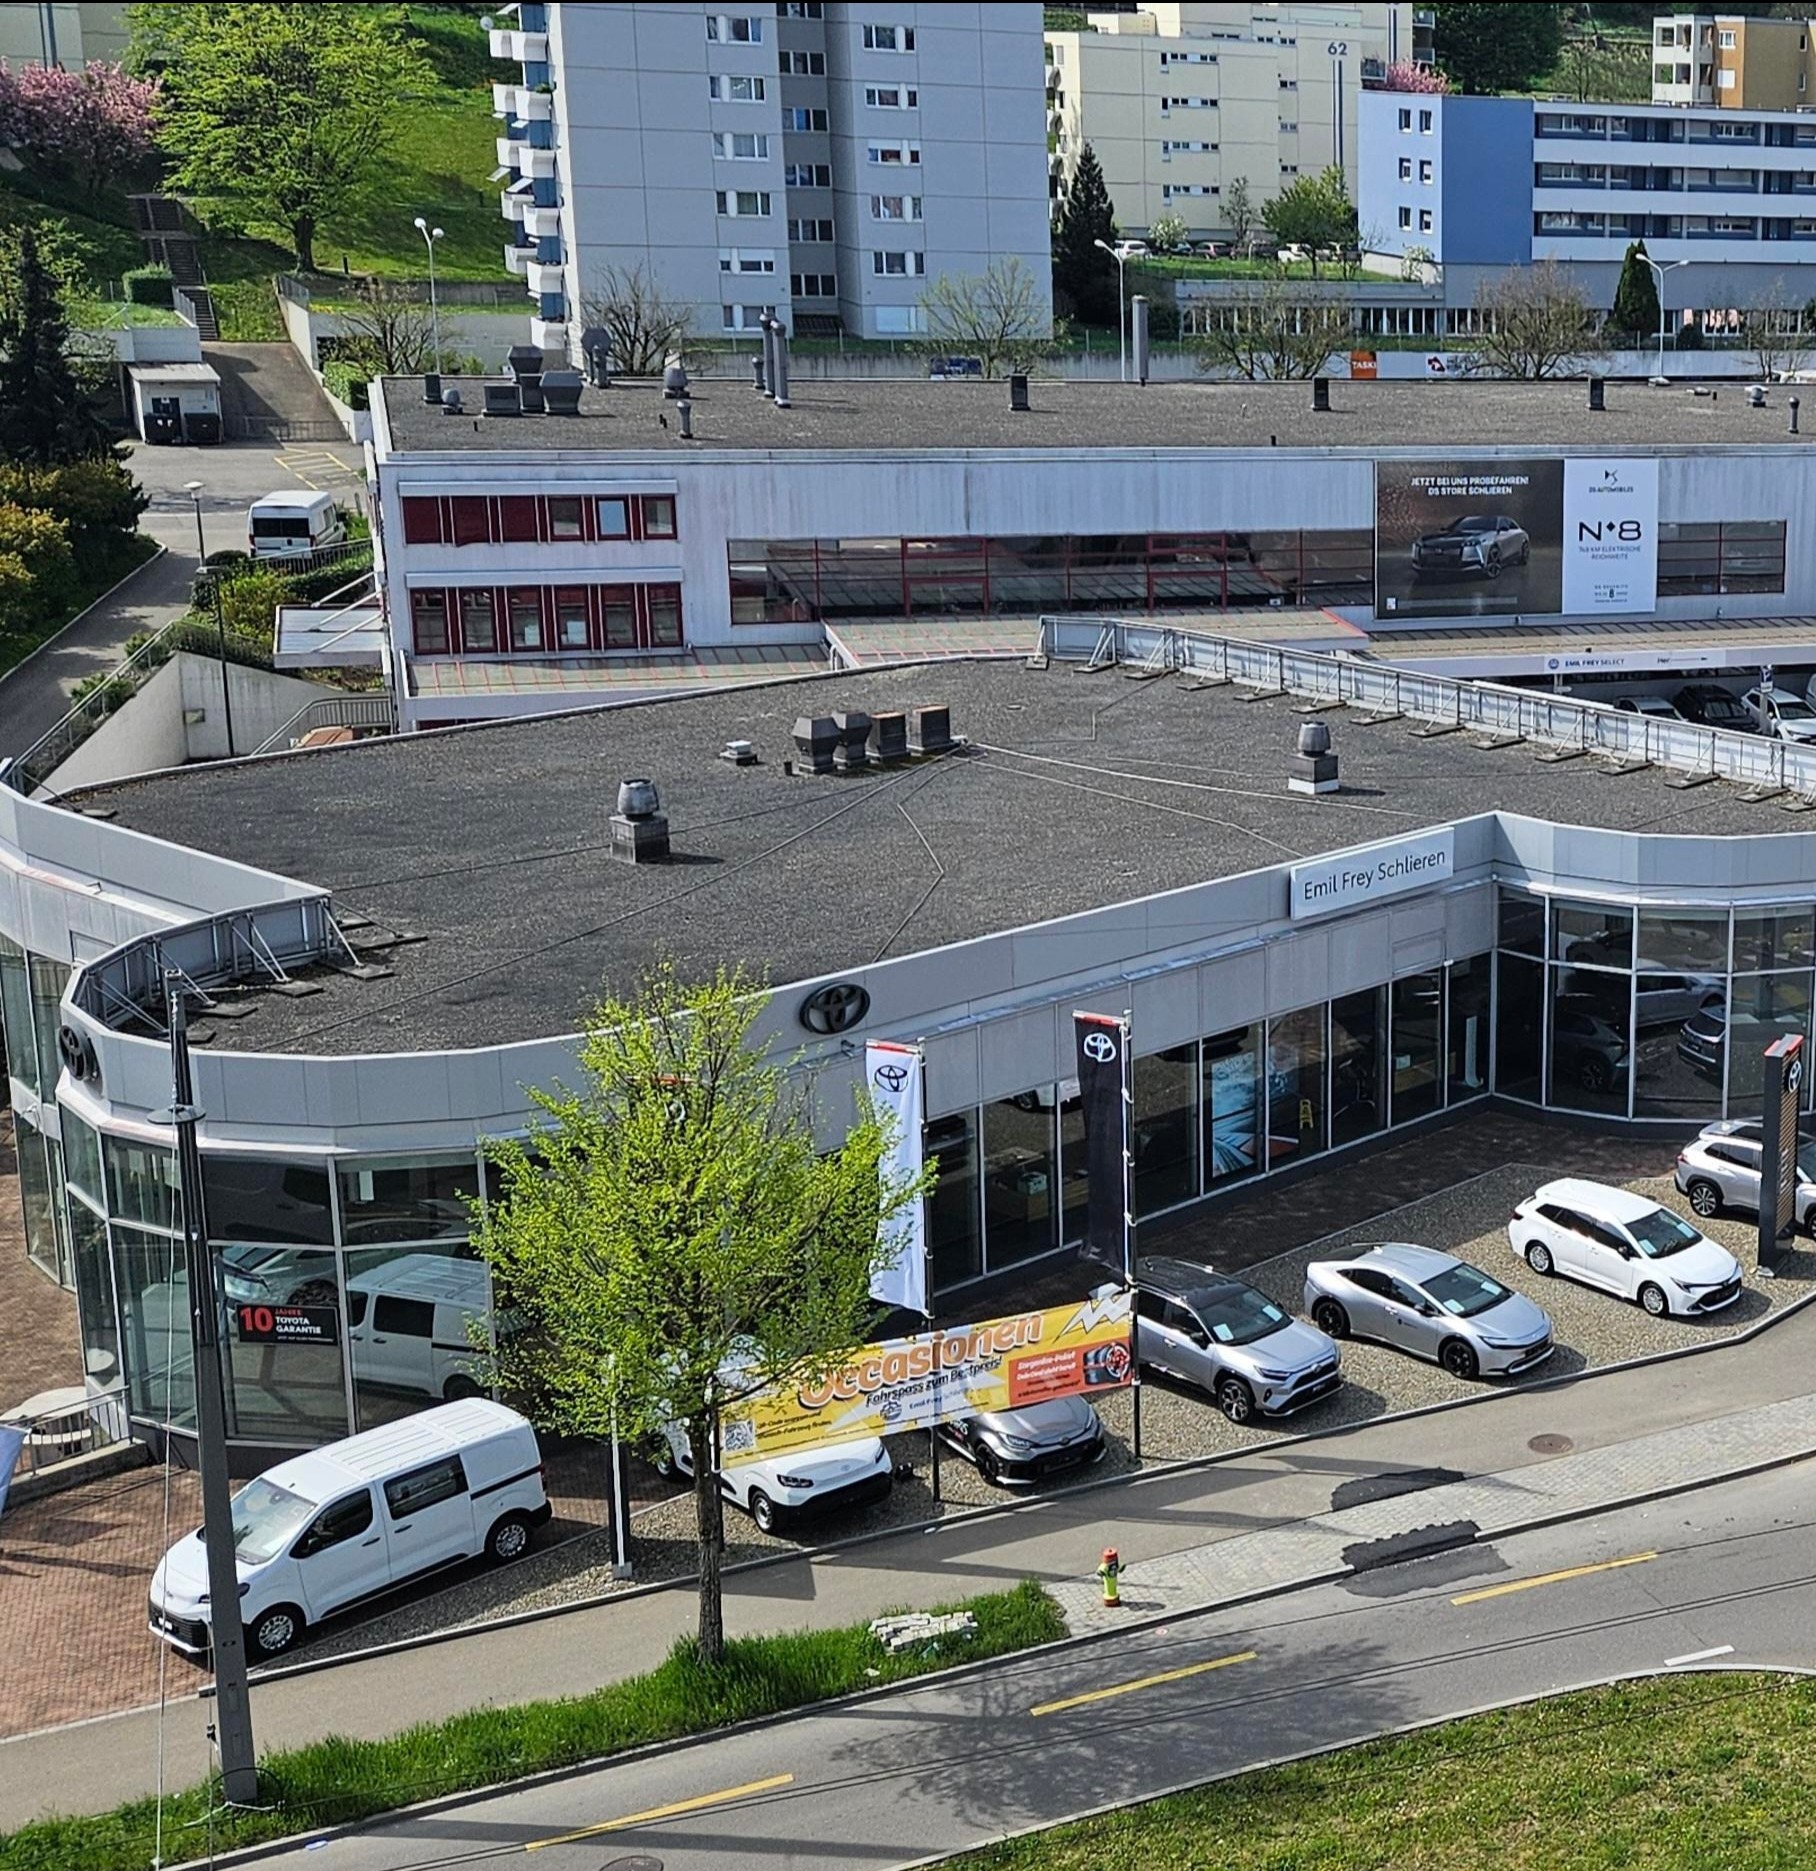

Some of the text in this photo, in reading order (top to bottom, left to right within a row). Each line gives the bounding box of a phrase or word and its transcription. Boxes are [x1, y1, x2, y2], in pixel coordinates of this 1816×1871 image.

[1328, 42, 1347, 55] 62
[1351, 361, 1376, 369] TASKI
[1411, 477, 1435, 486] JETZT
[1437, 477, 1449, 486] BEI
[1451, 477, 1468, 486] UNS
[1428, 486, 1512, 495] DS STORE SCHLIEREN
[1601, 658, 1625, 666] SELECT
[1304, 851, 1445, 899] Emil Frey Schlieren
[240, 1307, 273, 1332] 10
[275, 1316, 310, 1325] TOYOTA
[276, 1325, 321, 1335] GARANTIE
[799, 1314, 1043, 1407] Occasionen
[866, 1383, 923, 1407] Fahrspass
[925, 1375, 948, 1391] zum
